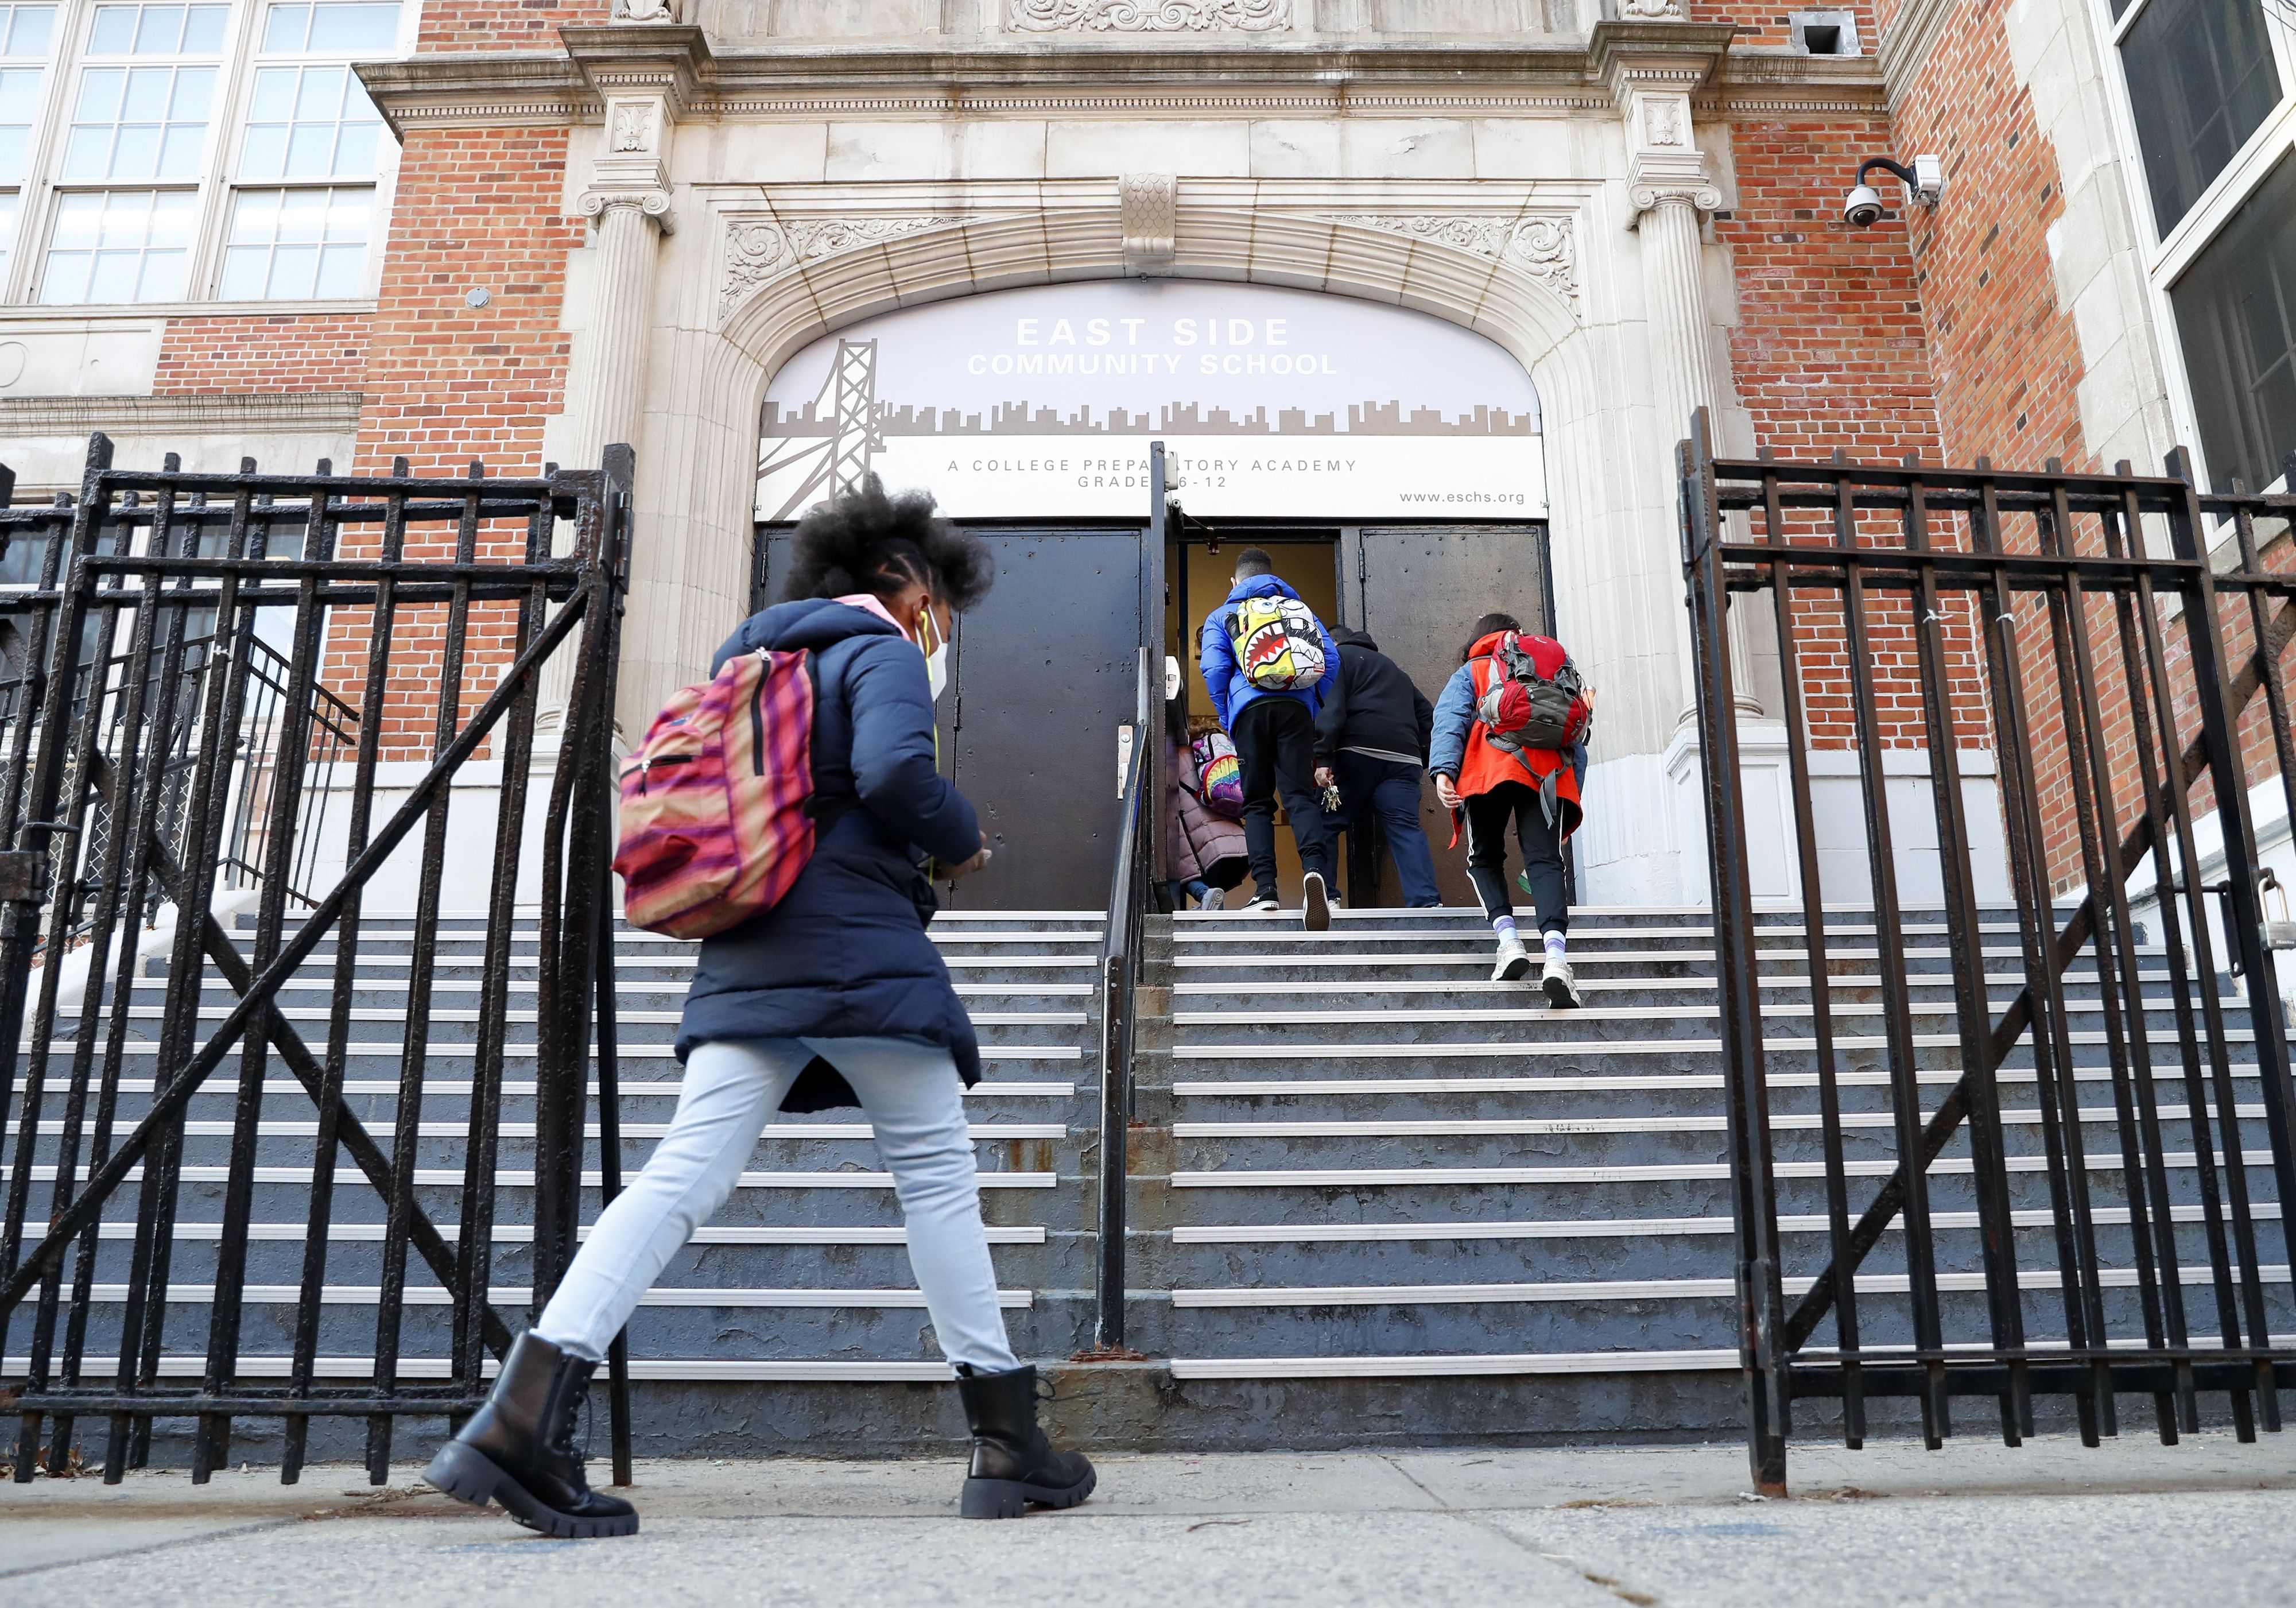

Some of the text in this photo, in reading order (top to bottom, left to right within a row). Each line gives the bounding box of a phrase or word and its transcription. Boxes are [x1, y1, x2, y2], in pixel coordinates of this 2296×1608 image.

[1017, 318, 1288, 346] EAST SIDE
[968, 354, 1337, 375] COMMUNITY SCHOOL
[948, 459, 1355, 471] A COLLEGE PREPATORY ACADEMY
[1078, 476, 1149, 487] GRADE
[1399, 491, 1524, 505] www.eschs.org
